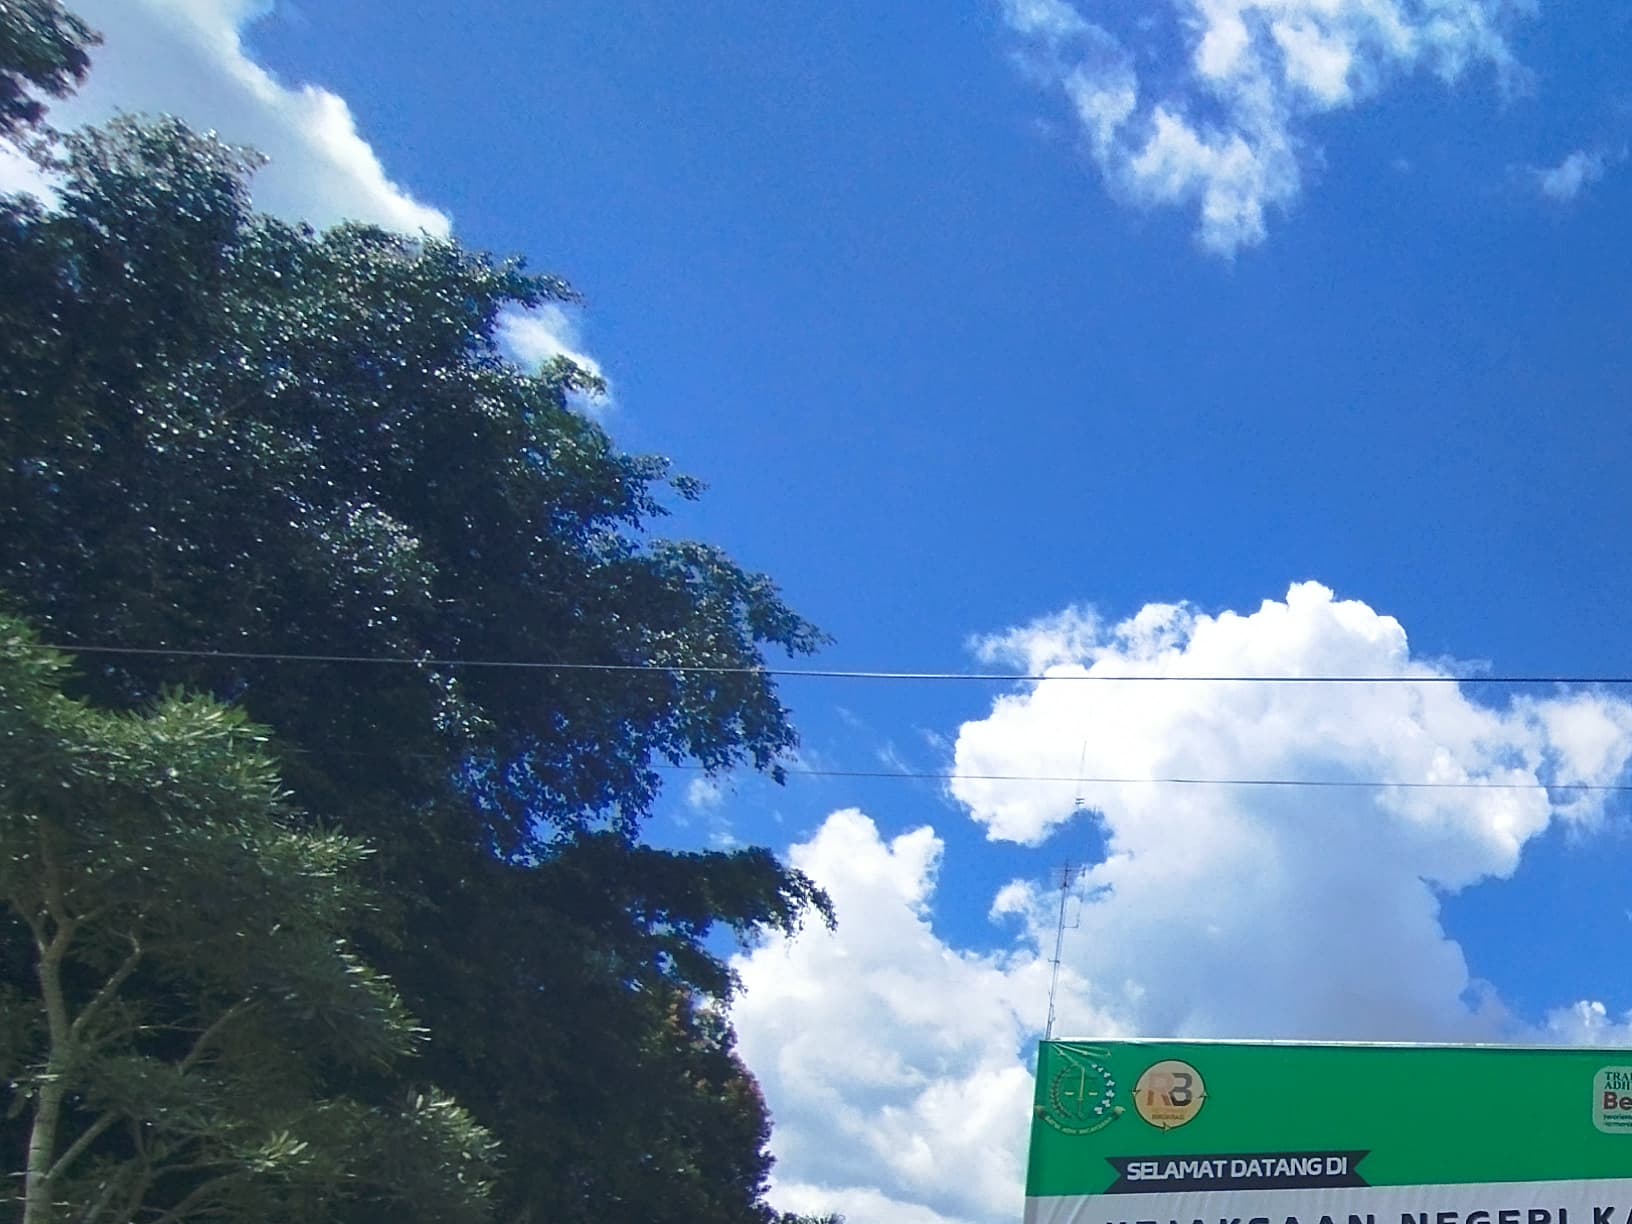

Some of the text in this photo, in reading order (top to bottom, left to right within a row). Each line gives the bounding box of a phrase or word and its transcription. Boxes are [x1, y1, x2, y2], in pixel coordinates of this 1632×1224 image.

[1126, 1156, 1348, 1181] SELAMAT DATANG DI
